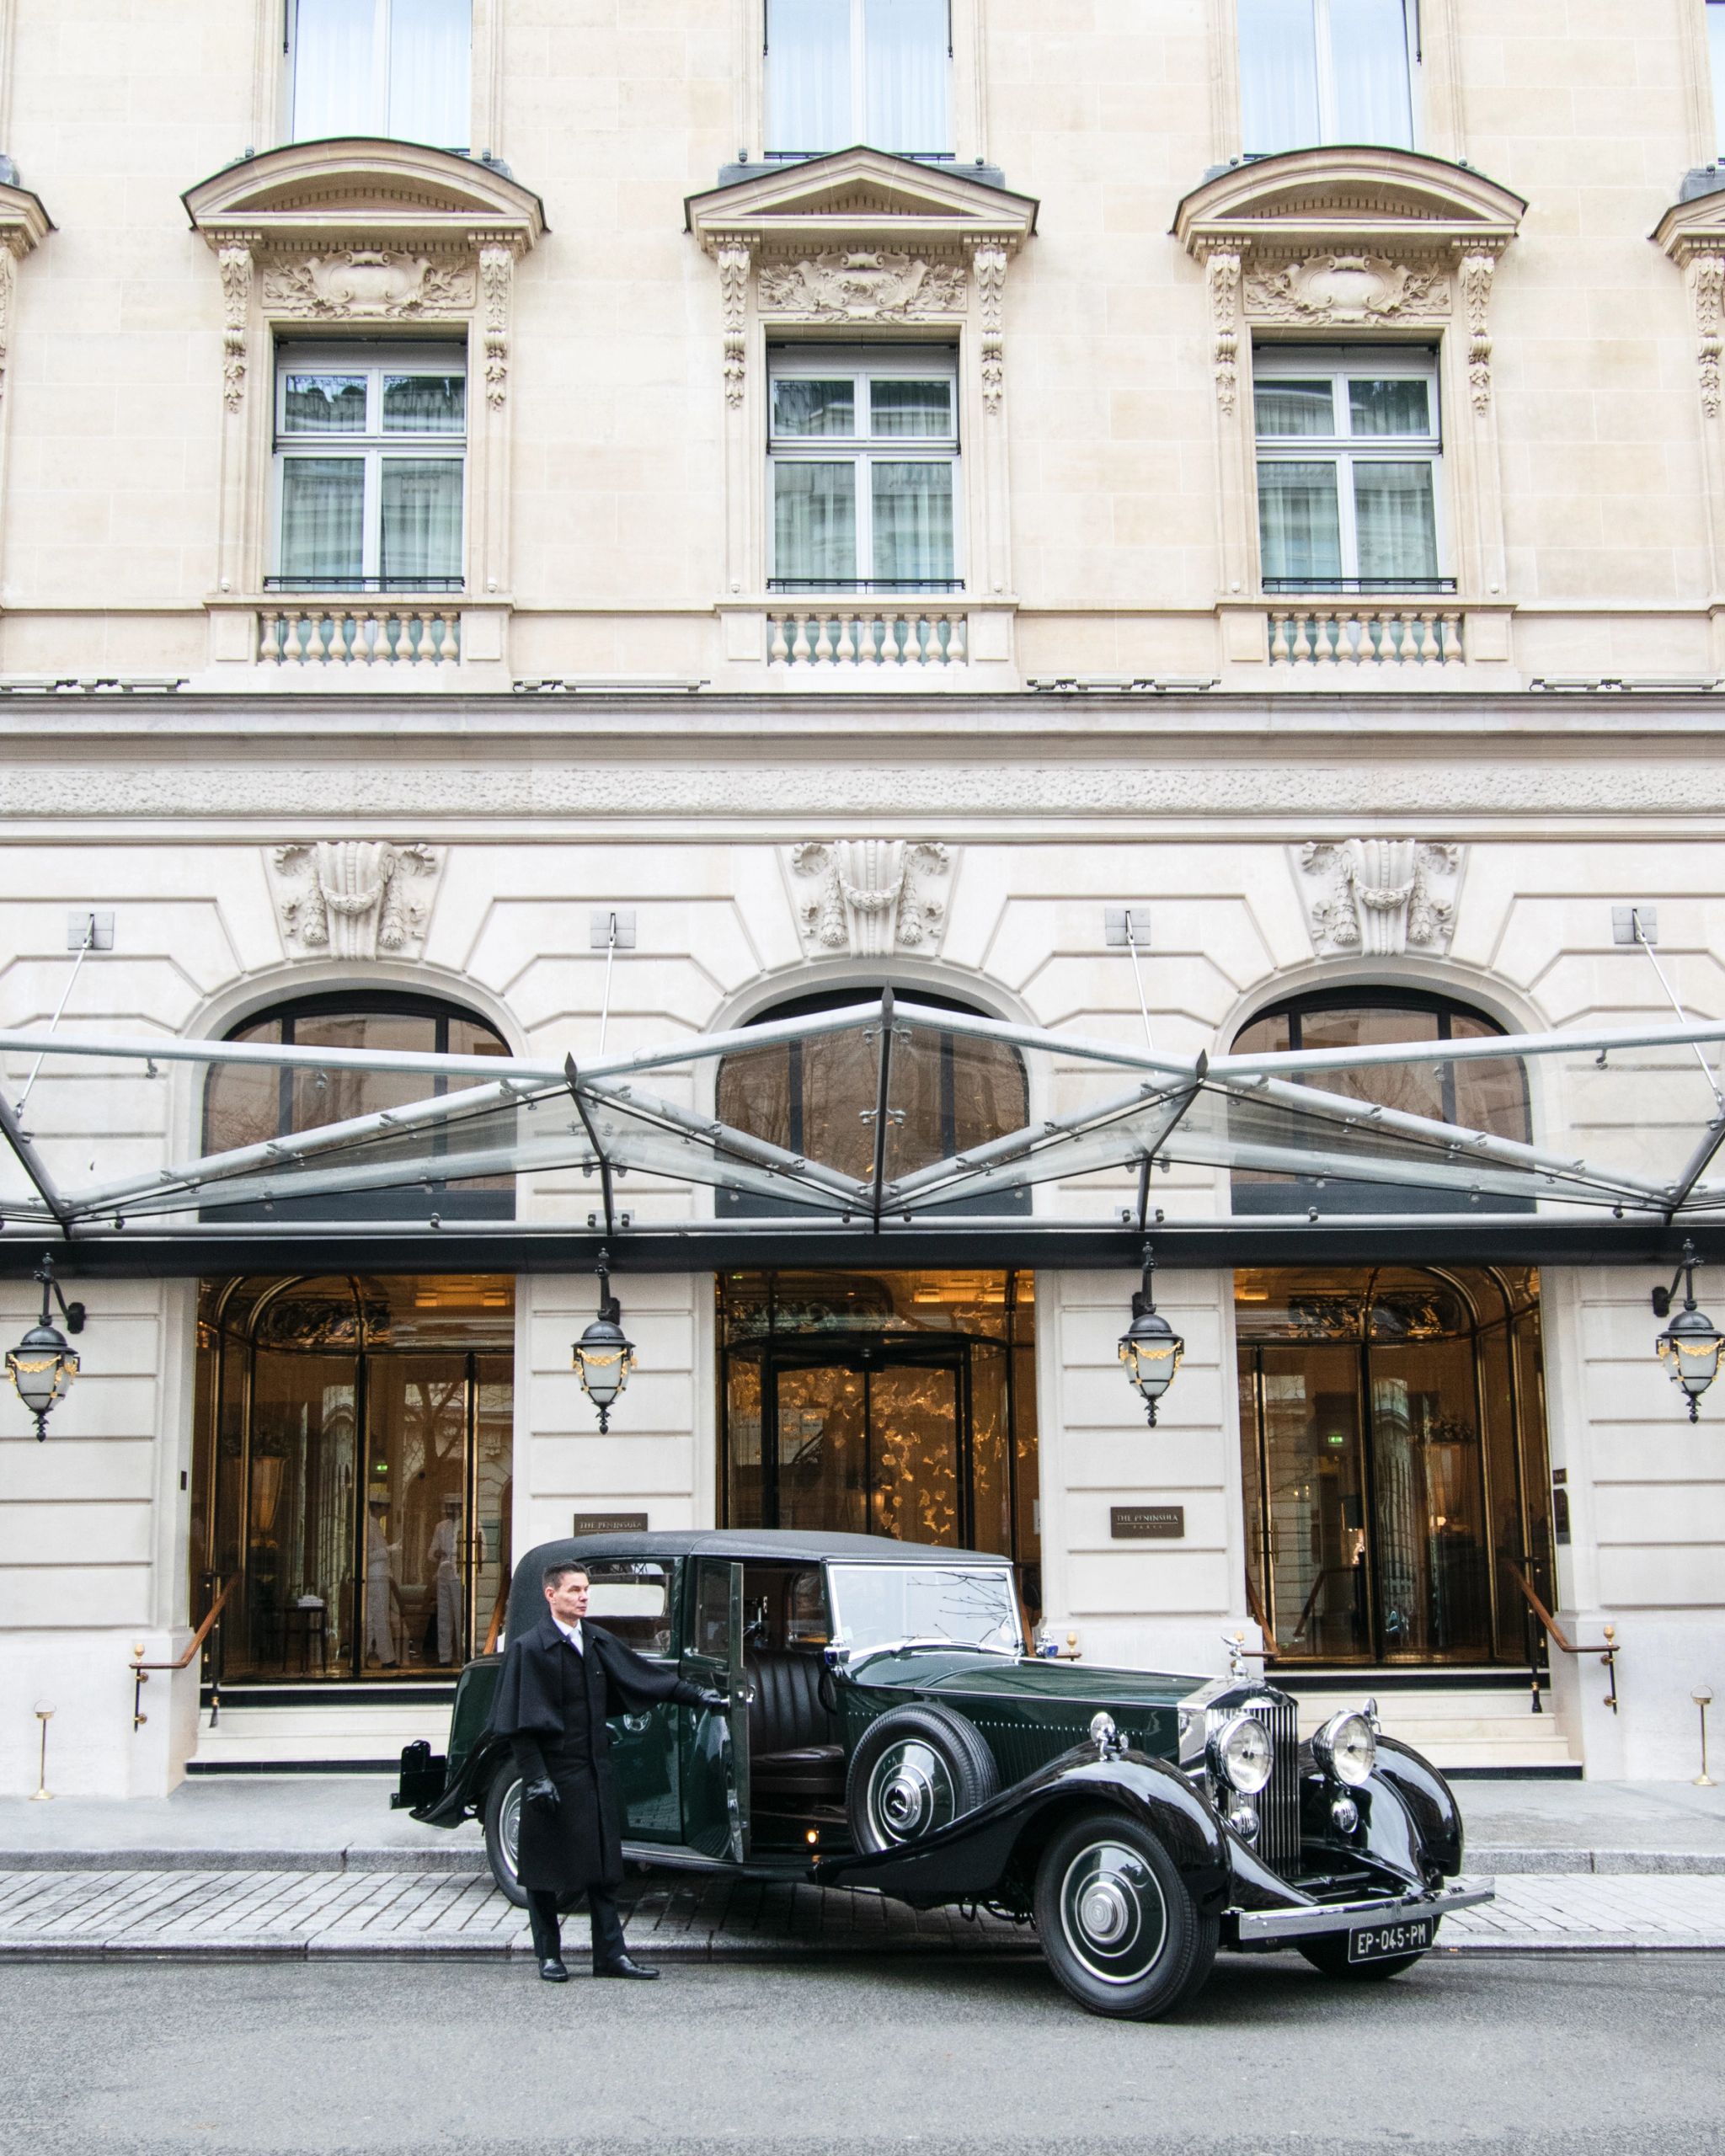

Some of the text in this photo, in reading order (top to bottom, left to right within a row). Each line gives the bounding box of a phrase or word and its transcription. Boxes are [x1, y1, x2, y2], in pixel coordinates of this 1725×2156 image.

[1134, 1513, 1178, 1522] PENINSULA
[579, 1520, 642, 1529] THE PENINSULA
[1357, 1923, 1426, 1955] EP-045-PM
